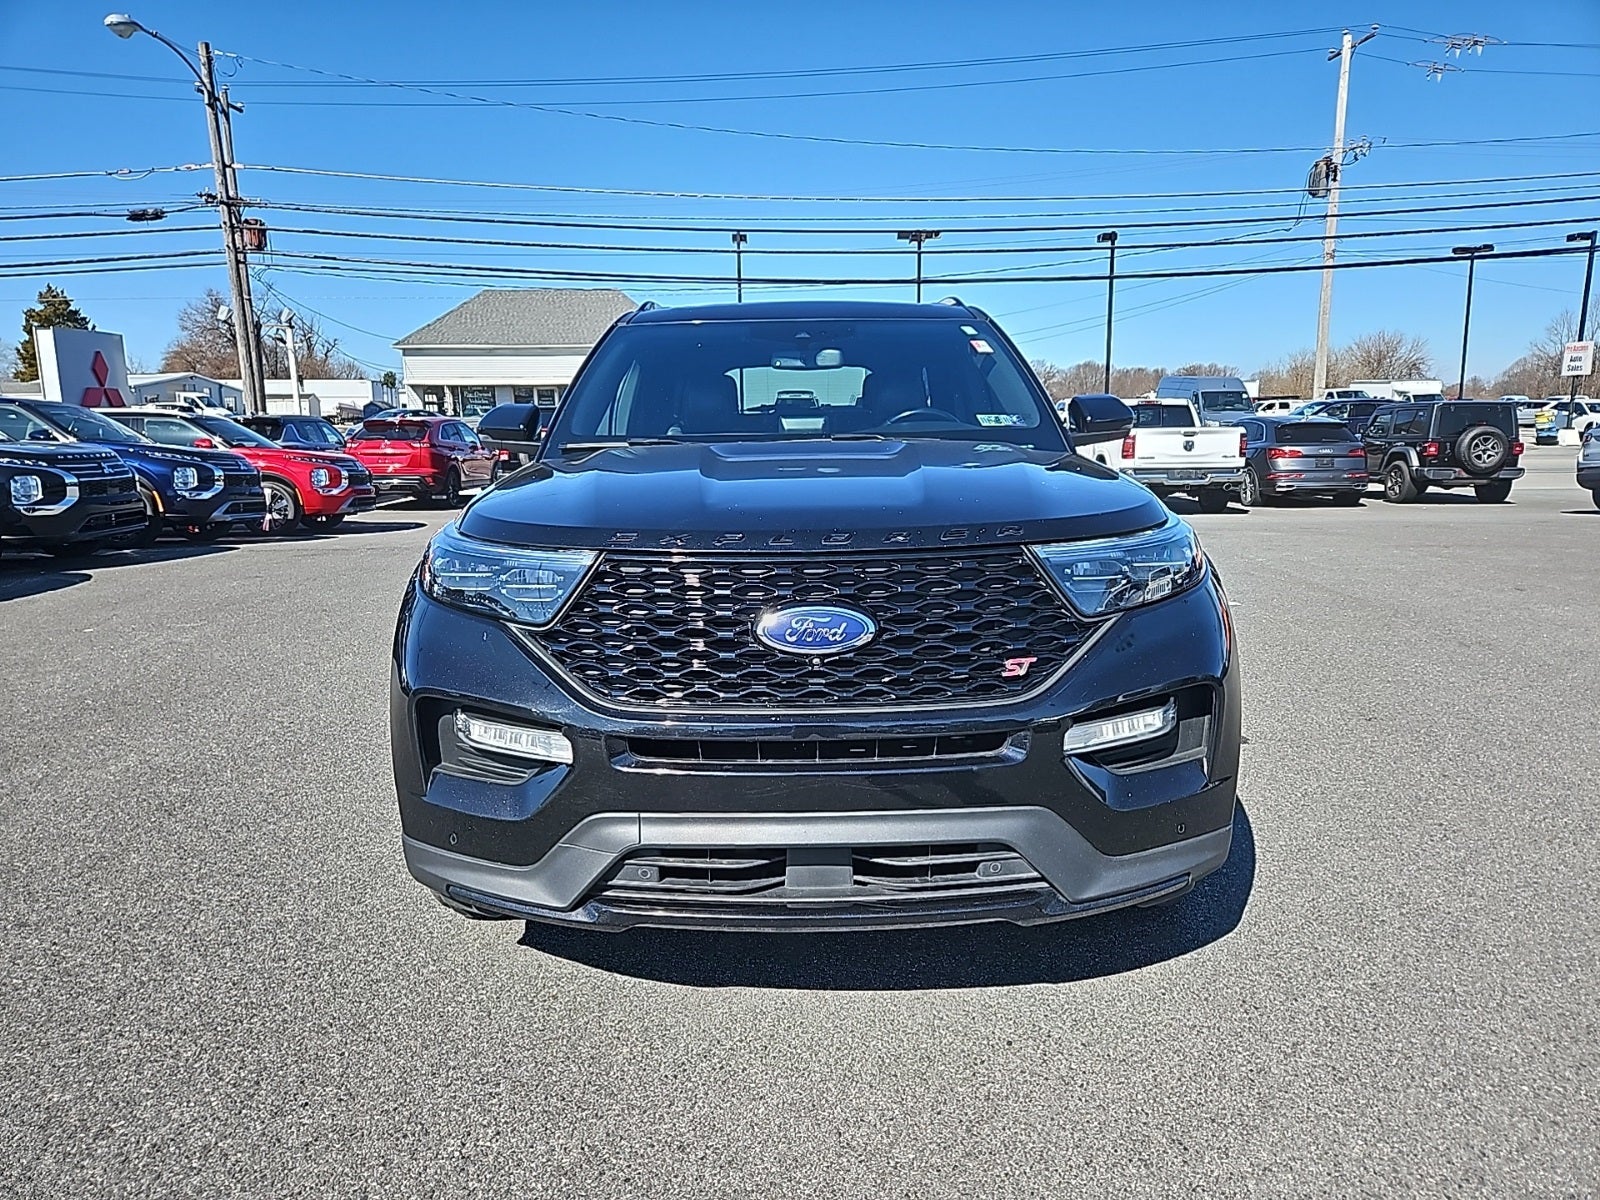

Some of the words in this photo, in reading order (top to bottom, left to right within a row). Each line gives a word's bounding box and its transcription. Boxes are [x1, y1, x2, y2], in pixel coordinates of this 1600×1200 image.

[1567, 364, 1583, 372] Sales
[606, 525, 1024, 546] EXPLORER
[784, 616, 848, 643] Ford
[1002, 656, 1038, 677] ST
